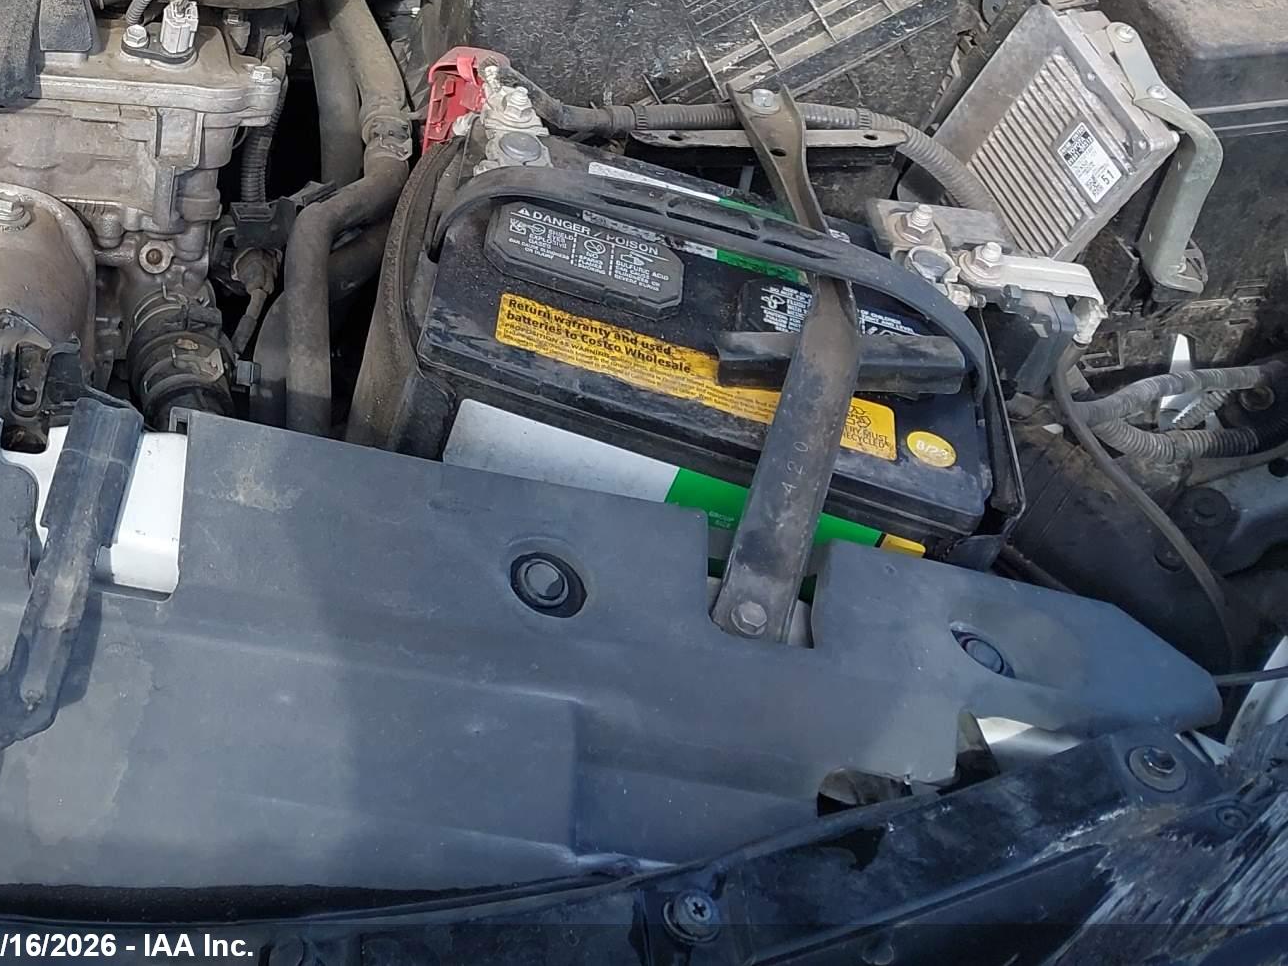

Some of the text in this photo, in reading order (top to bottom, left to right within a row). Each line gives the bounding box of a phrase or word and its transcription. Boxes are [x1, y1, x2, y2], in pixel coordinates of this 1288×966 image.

[1101, 170, 1114, 185] 51
[533, 211, 590, 235] DANGER
[606, 234, 658, 255] POISON
[506, 309, 562, 335] batteries
[565, 328, 578, 340] to
[581, 334, 621, 353] Costco
[509, 300, 672, 356] Return warranty and used
